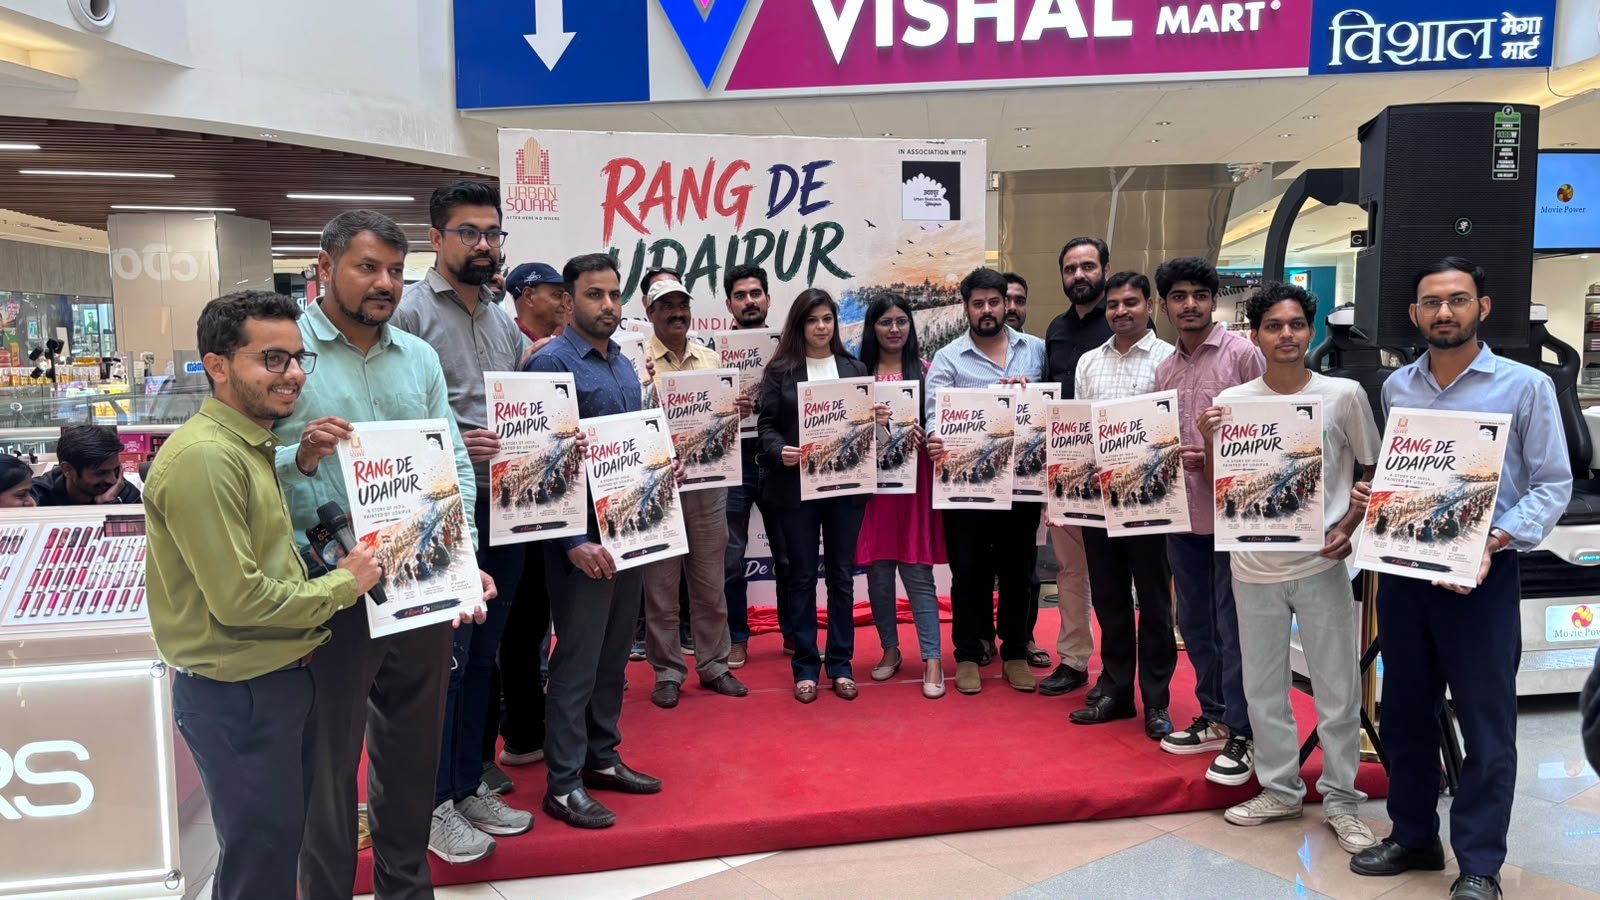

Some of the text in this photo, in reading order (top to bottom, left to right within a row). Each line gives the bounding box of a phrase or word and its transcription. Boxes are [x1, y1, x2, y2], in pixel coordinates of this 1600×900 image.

[1156, 1, 1265, 35] MART
[1501, 12, 1542, 36] मेगा
[812, 0, 1133, 64] VISHAL
[1327, 9, 1498, 67] विशाल
[1501, 37, 1541, 61] मार्ट
[508, 186, 557, 200] URBAN
[601, 157, 836, 247] RANG DE
[506, 197, 559, 214] SQUARE
[1540, 206, 1586, 214] Movie Power
[607, 220, 856, 305] UDAIPUR
[721, 347, 760, 364] RANG DE
[667, 390, 710, 408] RANG DE
[667, 400, 713, 420] UDAIPUR
[804, 399, 845, 417] RANG DE
[1016, 403, 1030, 414] DE
[494, 400, 544, 424] RANG DE
[804, 409, 848, 429] UDAIPUR
[940, 408, 984, 424] RANG DE
[496, 416, 551, 439] UDAIPUR
[940, 420, 988, 436] UDAIPUR
[1051, 421, 1092, 437] RANG DE
[1098, 418, 1144, 440] RANG DE
[1220, 422, 1279, 444] RANG DE
[591, 438, 636, 464] RANG DE
[1051, 434, 1094, 449] UDAIPUR
[1100, 430, 1149, 454] UDAIPUR
[1220, 436, 1284, 458] UDAIPUR
[1388, 436, 1456, 456] RANG DE
[353, 456, 414, 488] RANG DE
[594, 451, 644, 478] UDAIPUR
[1384, 455, 1456, 472] UDAIPUR
[358, 474, 422, 506] UDAIPUR
[744, 560, 769, 578] De
